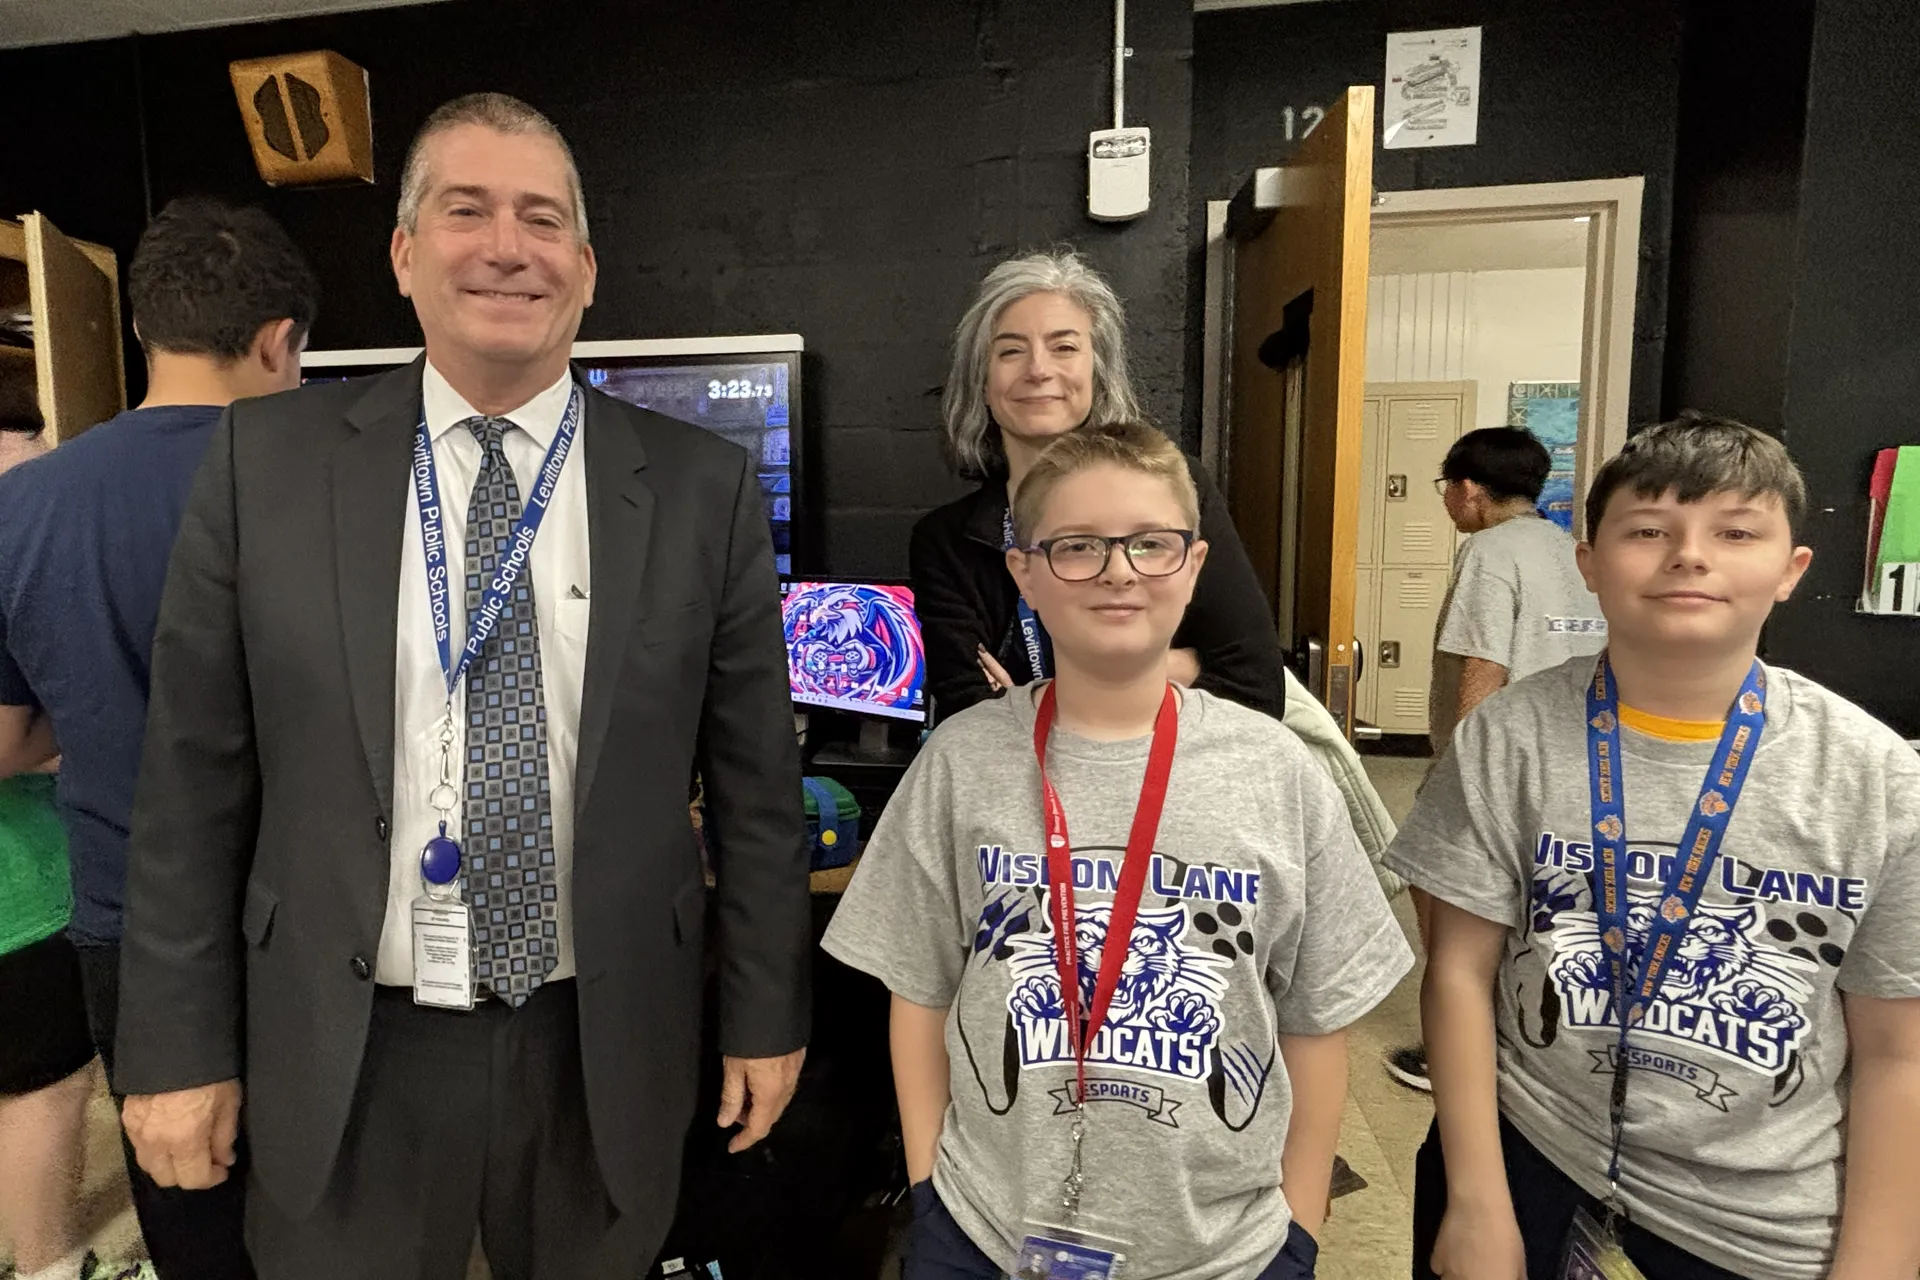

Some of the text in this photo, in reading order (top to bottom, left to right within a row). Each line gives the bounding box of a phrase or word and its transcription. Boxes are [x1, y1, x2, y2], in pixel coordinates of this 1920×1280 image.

[531, 437, 570, 509] Levittown
[421, 505, 444, 563] Public
[428, 565, 449, 643] Schools
[466, 526, 535, 655] Public Schools
[1020, 617, 1044, 681] Levittown
[1150, 854, 1260, 905] LANE
[1721, 855, 1867, 912] LANE
[1059, 882, 1072, 966] PRACTICE FIRE PREVENTION
[1020, 1015, 1202, 1078] WIDCATS
[1567, 986, 1780, 1069] WDCATS
